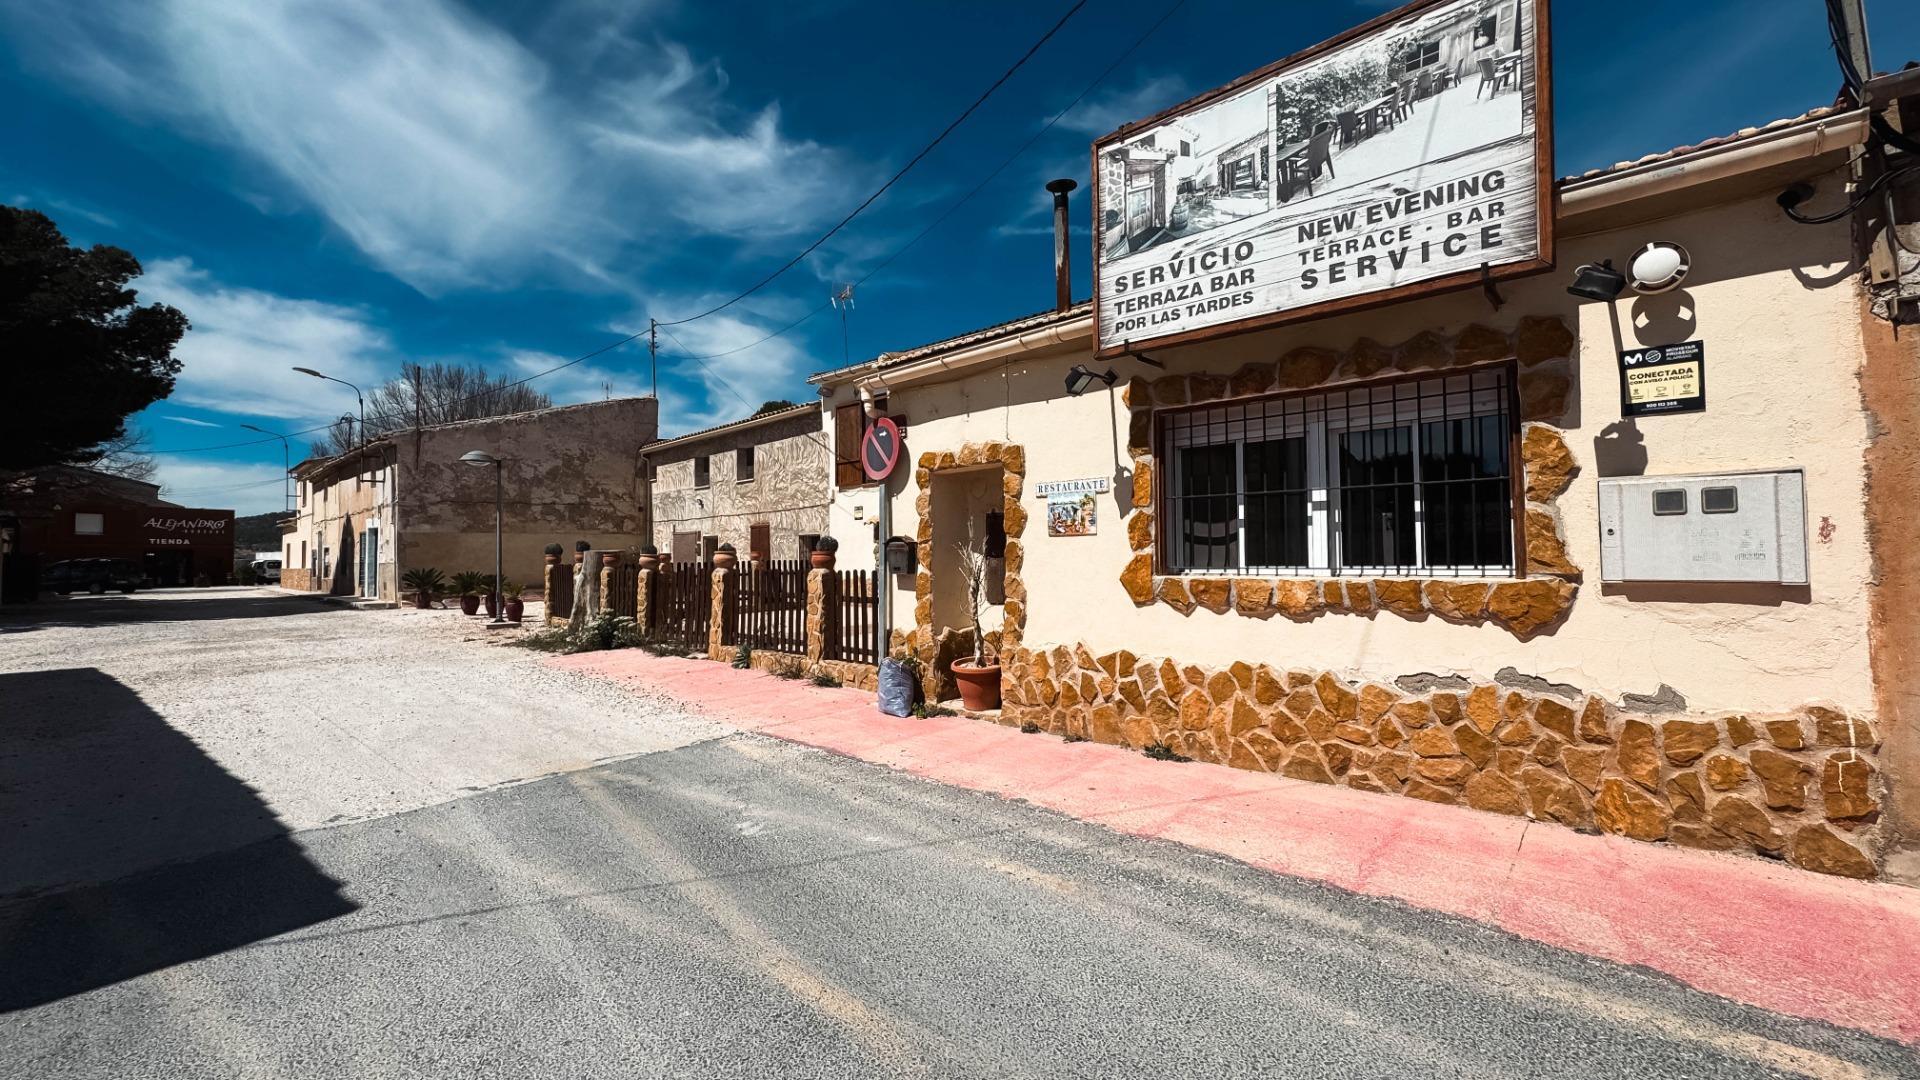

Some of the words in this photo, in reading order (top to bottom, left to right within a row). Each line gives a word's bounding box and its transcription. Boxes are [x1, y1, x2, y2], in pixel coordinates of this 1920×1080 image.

[1298, 211, 1356, 243] NEW
[1366, 170, 1505, 225] EVENING
[1298, 225, 1413, 265] TERRACE
[1447, 201, 1505, 229] BAR
[1301, 223, 1503, 290] SERVICE
[1114, 282, 1203, 316] TERRAZA
[1210, 268, 1255, 293] BAR
[1115, 241, 1254, 294] SERVICIO
[1115, 317, 1146, 333] POR
[1151, 308, 1181, 325] LAS
[1186, 291, 1254, 317] TARDES
[1629, 367, 1693, 380] CONECTADA
[1038, 480, 1105, 493] RESTAURANTE
